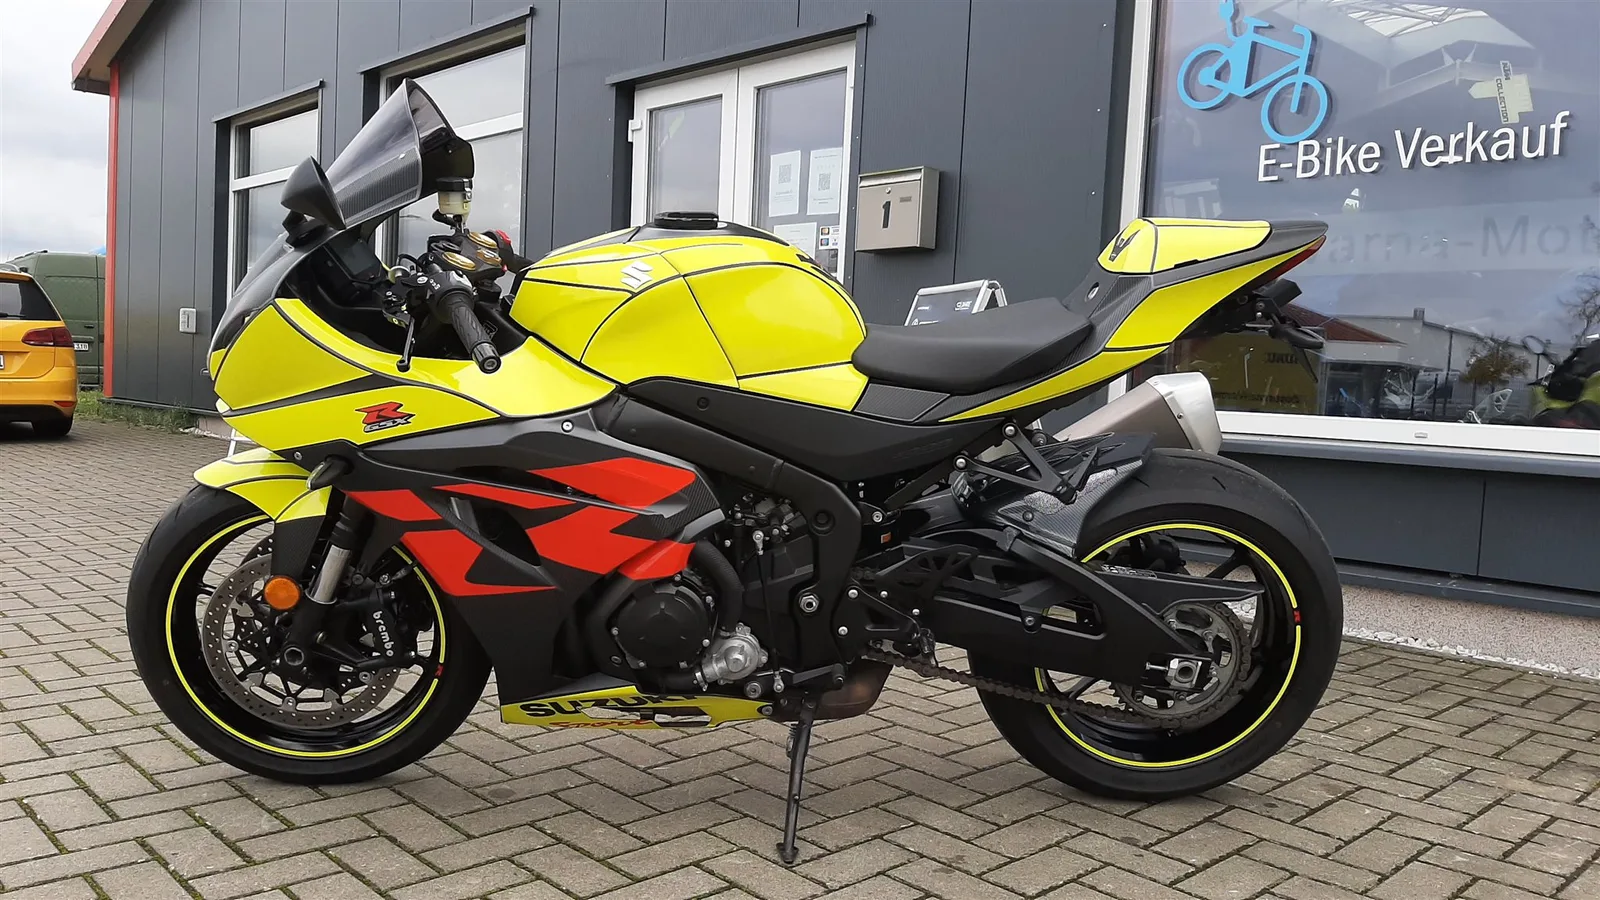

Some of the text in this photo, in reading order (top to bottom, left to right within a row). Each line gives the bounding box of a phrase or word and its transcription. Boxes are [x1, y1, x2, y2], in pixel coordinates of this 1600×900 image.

[1496, 78, 1509, 122] COLLECTION
[1257, 110, 1570, 183] E-Bike Verkauf
[882, 200, 891, 229] 1
[373, 611, 394, 656] brembo
